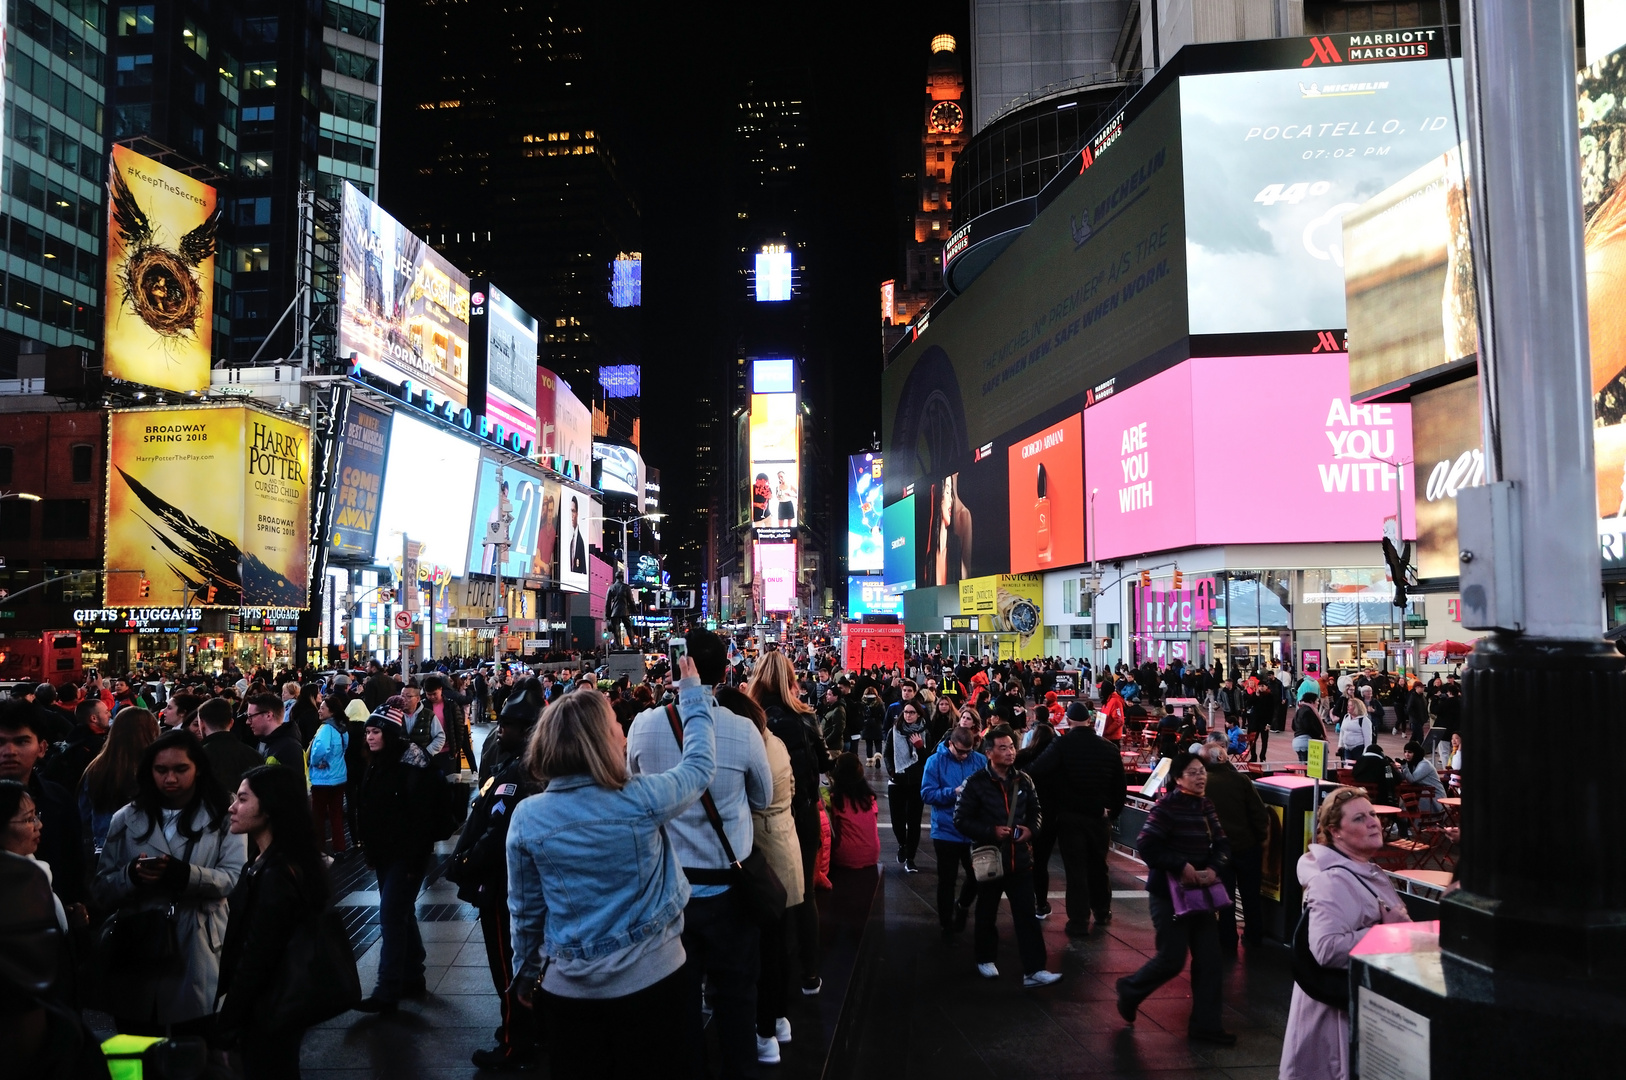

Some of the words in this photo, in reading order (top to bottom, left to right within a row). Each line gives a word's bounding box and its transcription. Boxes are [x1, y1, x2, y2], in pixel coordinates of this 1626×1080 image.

[1350, 31, 1436, 46] MARRIOTT
[1350, 44, 1426, 60] MARQUIS
[1322, 80, 1390, 94] MICHELIN
[1094, 112, 1124, 148] MARRIOTT
[1244, 119, 1406, 142] POCATELLO,
[1419, 116, 1448, 132] ID
[1094, 127, 1122, 158] MARQUIS
[1301, 147, 1356, 160] 07:02
[1363, 146, 1392, 156] PM
[127, 166, 208, 208] #KeepTheSecrets
[1093, 148, 1166, 226] MICHELIN
[946, 224, 972, 252] MARRIOTT
[357, 226, 413, 280] MARUEE
[472, 307, 484, 316] LG
[1083, 290, 1120, 329] WHEN
[386, 340, 436, 377] VORNADO
[1326, 398, 1393, 426] ARE
[144, 434, 182, 443] SPRING
[186, 433, 208, 442] 2018
[146, 424, 206, 434] BROADWAY
[254, 422, 302, 460] HARRY
[348, 422, 362, 439] BEST
[362, 426, 384, 448] MUSICAL
[402, 380, 472, 429] 1540
[477, 414, 583, 480] BROADWAY
[1042, 428, 1064, 450] ARMANI
[1120, 422, 1148, 456] ARE
[1326, 429, 1394, 460] YOU
[136, 454, 214, 462] HarryPotterThePlay.com
[249, 446, 305, 484] POTTER
[1121, 451, 1148, 484] YOU
[255, 480, 279, 494] CURSED
[280, 486, 299, 498] CHILD
[342, 466, 380, 490] COME
[1318, 464, 1404, 492] WITH
[1118, 480, 1153, 514] WITH
[257, 524, 281, 534] SPRING
[282, 526, 295, 536] 2018
[258, 514, 294, 527] BROADWAY
[336, 505, 376, 531] AWAY
[466, 580, 510, 608] FORER
[74, 609, 118, 620] GIFTS
[129, 608, 202, 621] LUGGAGE
[267, 609, 299, 619] LUGGAGE
[1147, 601, 1190, 622] NYC
